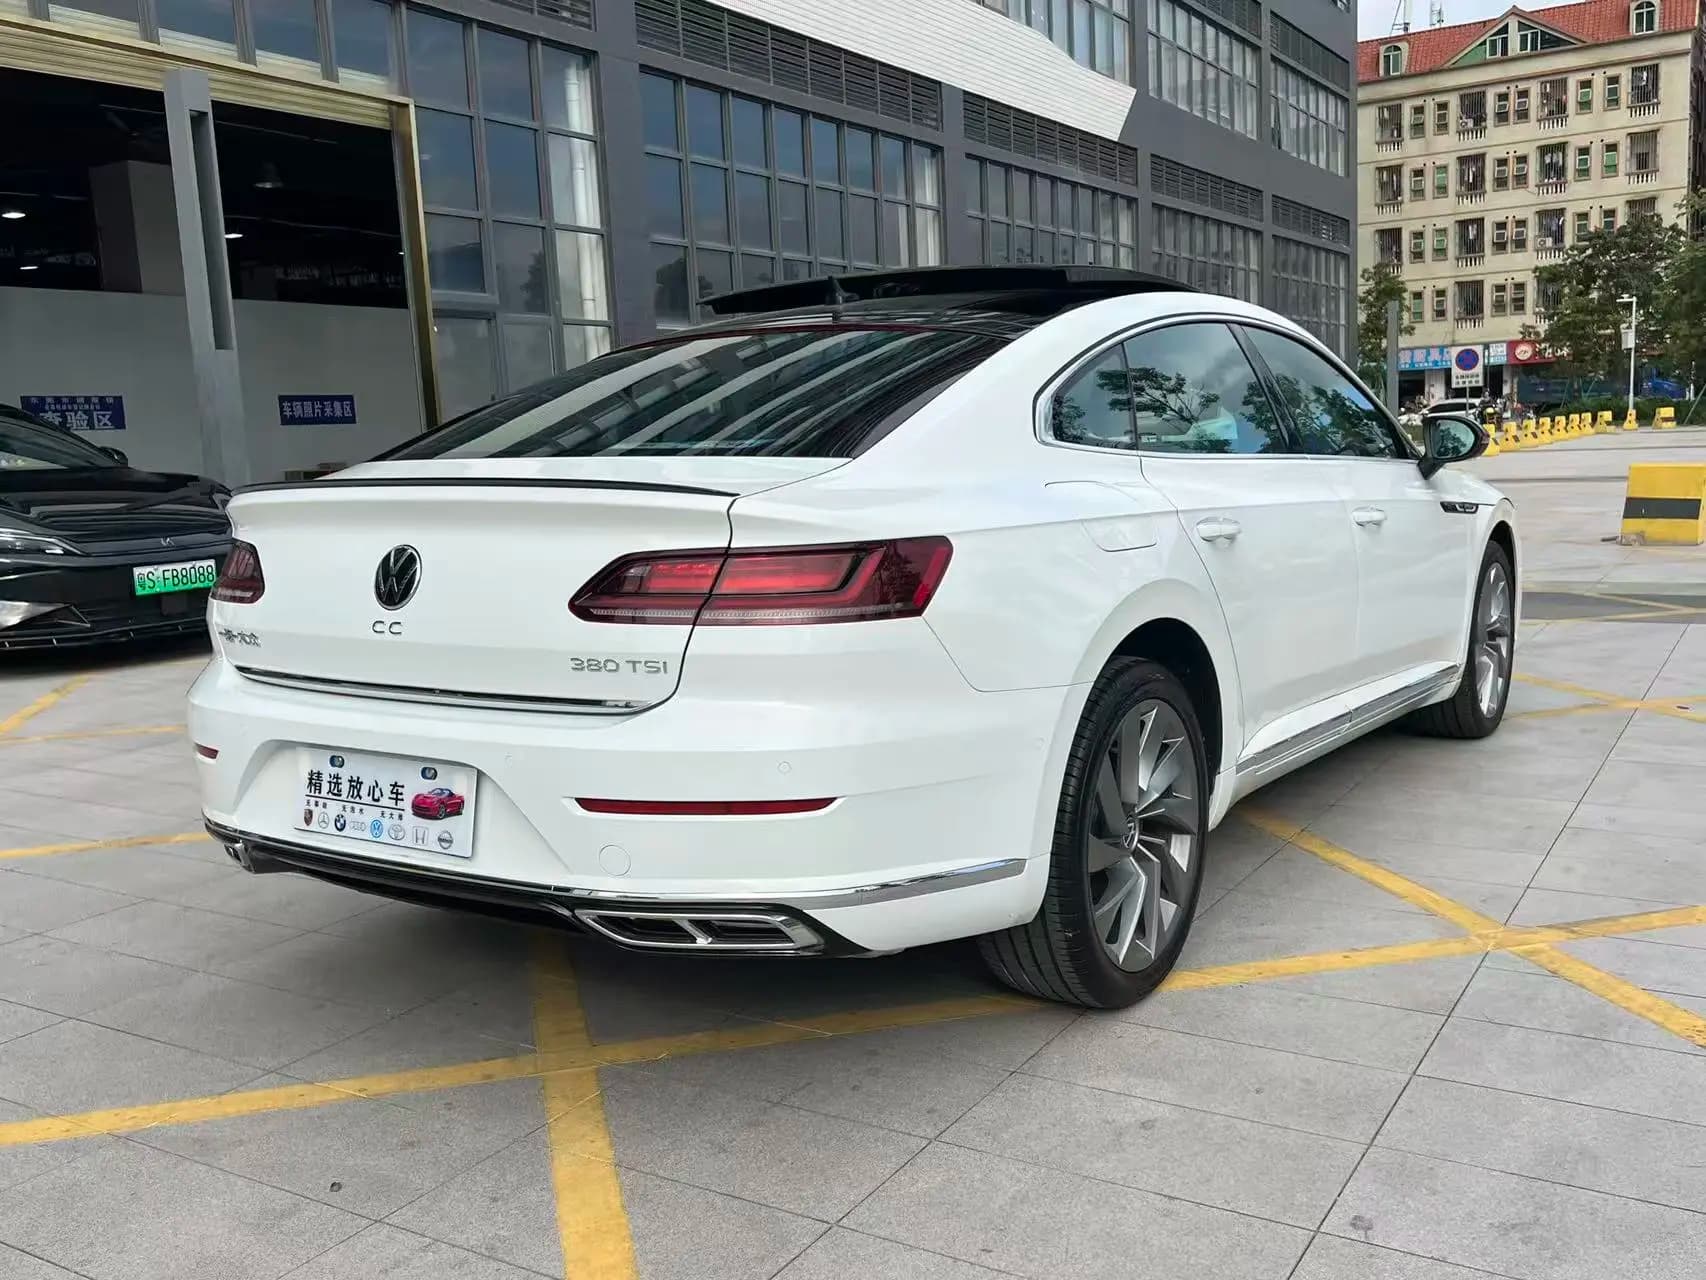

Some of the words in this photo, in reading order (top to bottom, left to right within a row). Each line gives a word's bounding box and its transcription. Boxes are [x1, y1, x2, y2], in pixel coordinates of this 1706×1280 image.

[371, 620, 403, 636] CC
[570, 657, 620, 673] 380
[625, 659, 668, 674] TSI
[306, 769, 405, 806] 精选放心车
